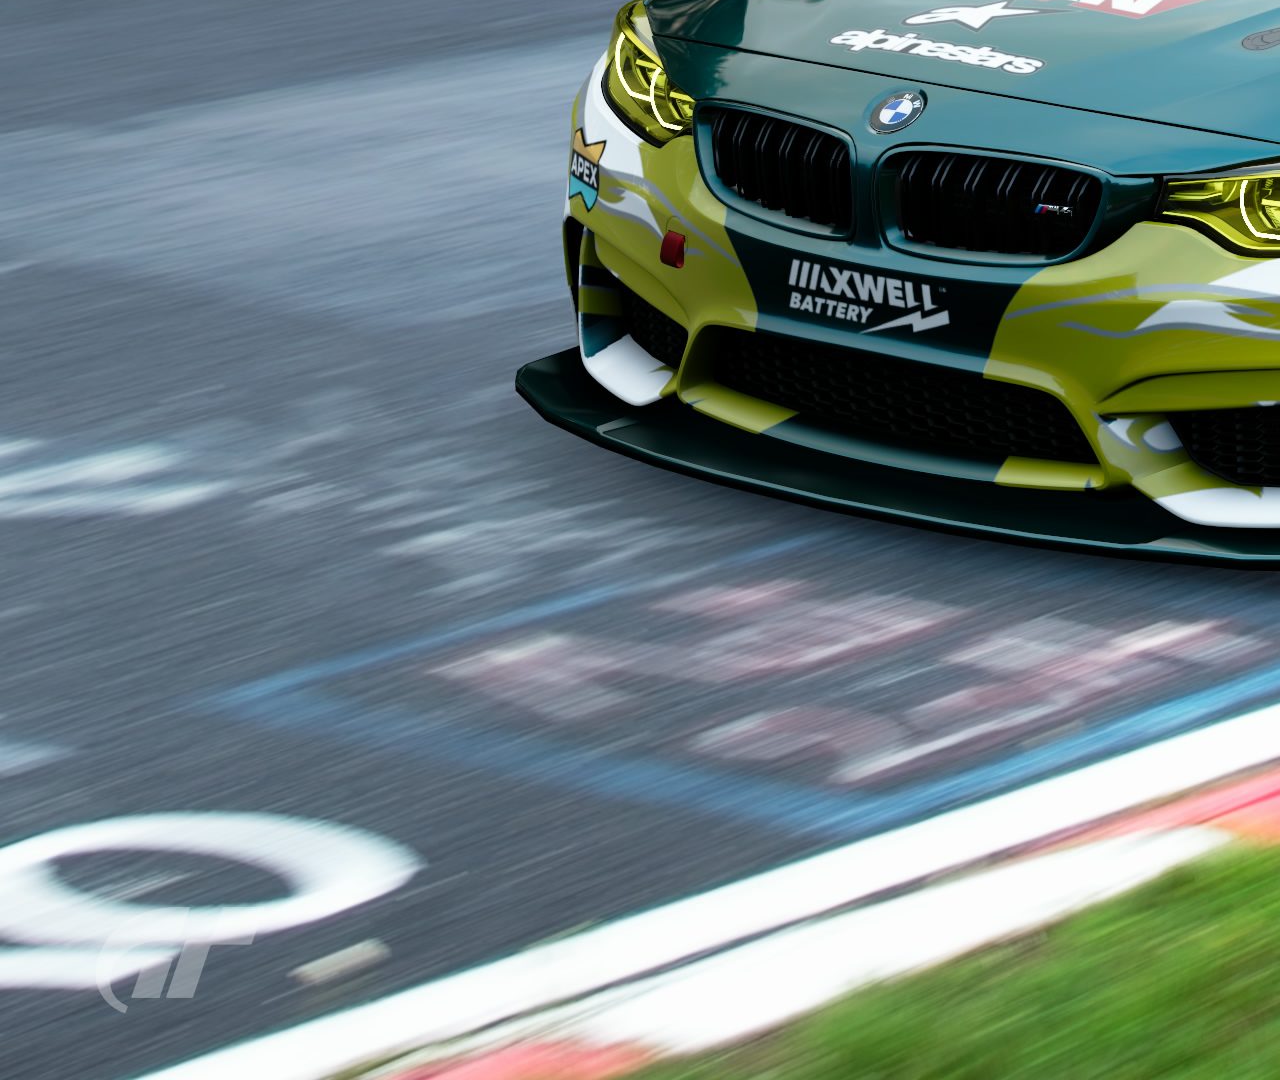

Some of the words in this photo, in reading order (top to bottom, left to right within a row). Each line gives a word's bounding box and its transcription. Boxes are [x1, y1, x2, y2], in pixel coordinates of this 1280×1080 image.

[829, 29, 1045, 75] alpinestars
[570, 152, 599, 190] APEX
[789, 291, 874, 325] BATTERY
